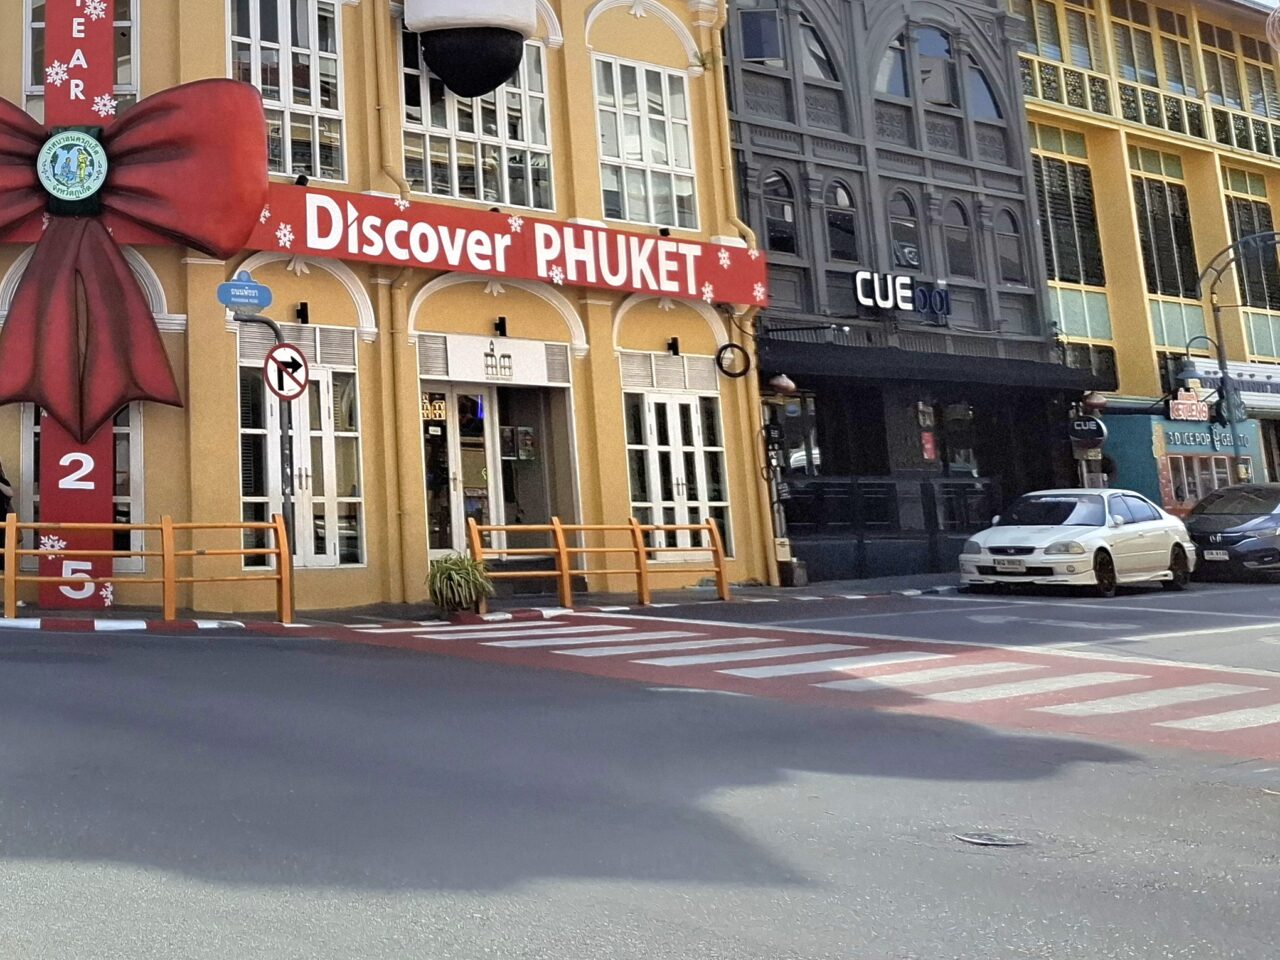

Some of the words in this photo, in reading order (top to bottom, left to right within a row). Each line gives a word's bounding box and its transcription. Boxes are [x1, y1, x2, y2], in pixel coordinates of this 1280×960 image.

[305, 193, 512, 273] Discover
[534, 222, 702, 296] PHUKET
[855, 270, 914, 311] CUE
[1073, 421, 1097, 430] CUE
[1182, 432, 1195, 445] ICE
[1195, 432, 1211, 445] POP
[1221, 433, 1250, 448] GELTO
